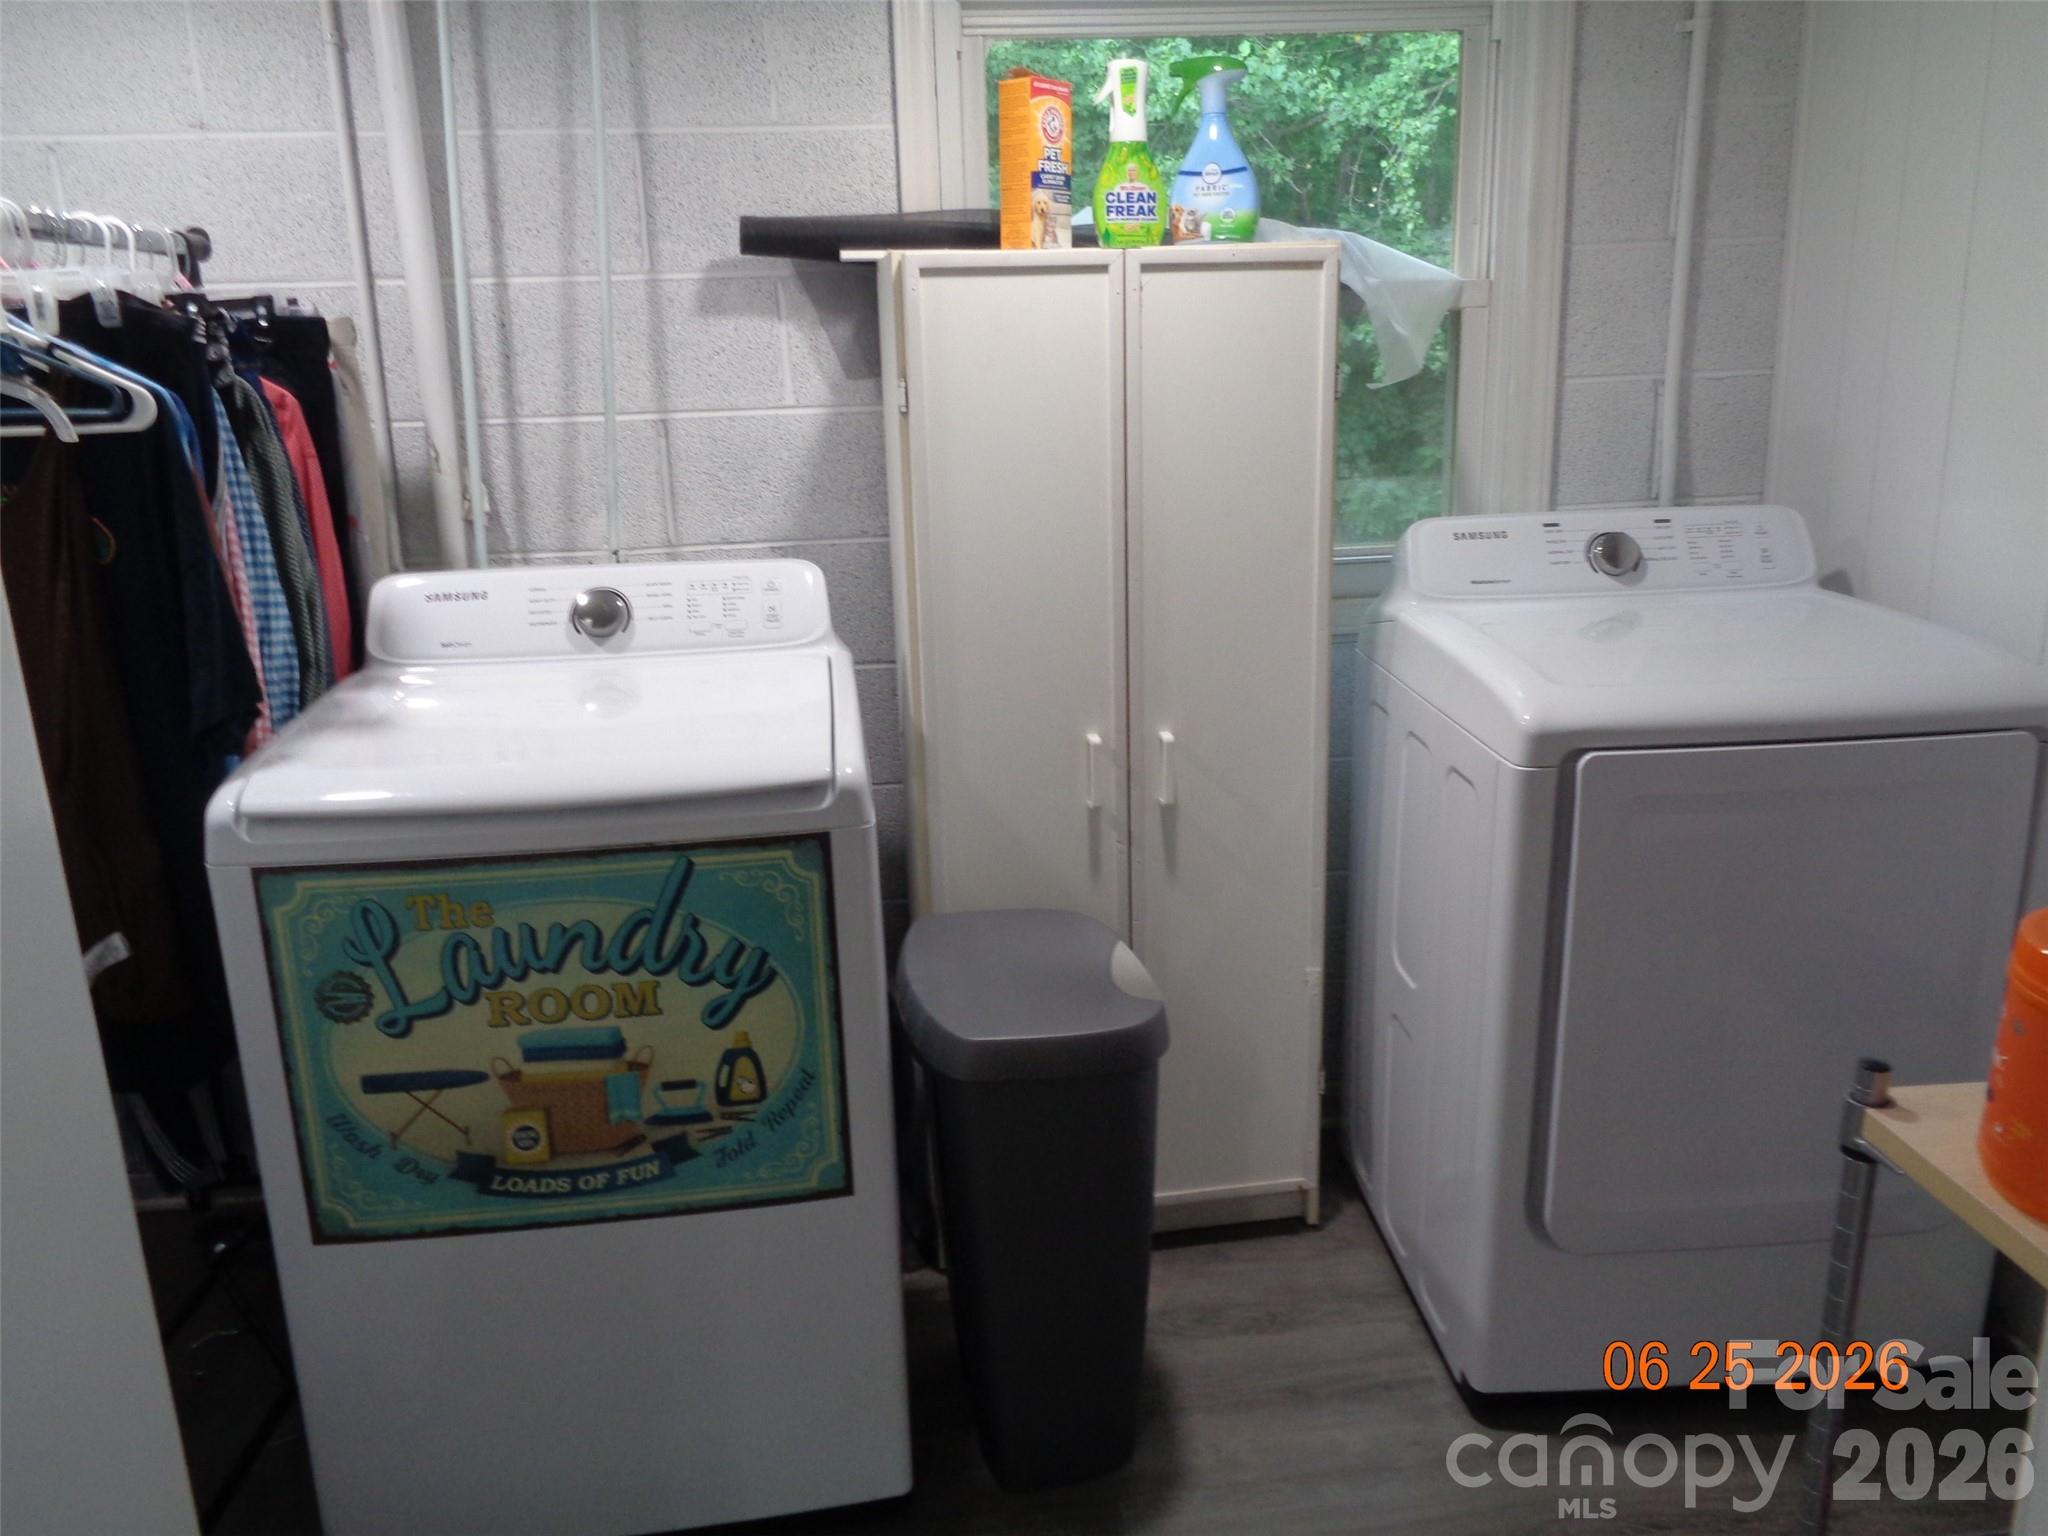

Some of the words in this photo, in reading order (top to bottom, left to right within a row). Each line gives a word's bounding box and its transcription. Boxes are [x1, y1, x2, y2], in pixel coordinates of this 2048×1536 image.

[1043, 147, 1062, 160] PET
[1038, 160, 1069, 174] FRESH
[1105, 192, 1157, 204] CLEAN
[1106, 205, 1157, 217] FREAK
[1452, 530, 1508, 541] SAMSUNG
[424, 590, 488, 603] SAMSUNG
[404, 893, 496, 932] The
[343, 855, 779, 1039] Laundry
[484, 978, 664, 1029] ROOM
[712, 1130, 758, 1168] Fold
[761, 1067, 817, 1132] Repeat
[489, 1175, 572, 1194] LOADS
[577, 1173, 610, 1190] OF
[617, 1160, 661, 1185] FUN
